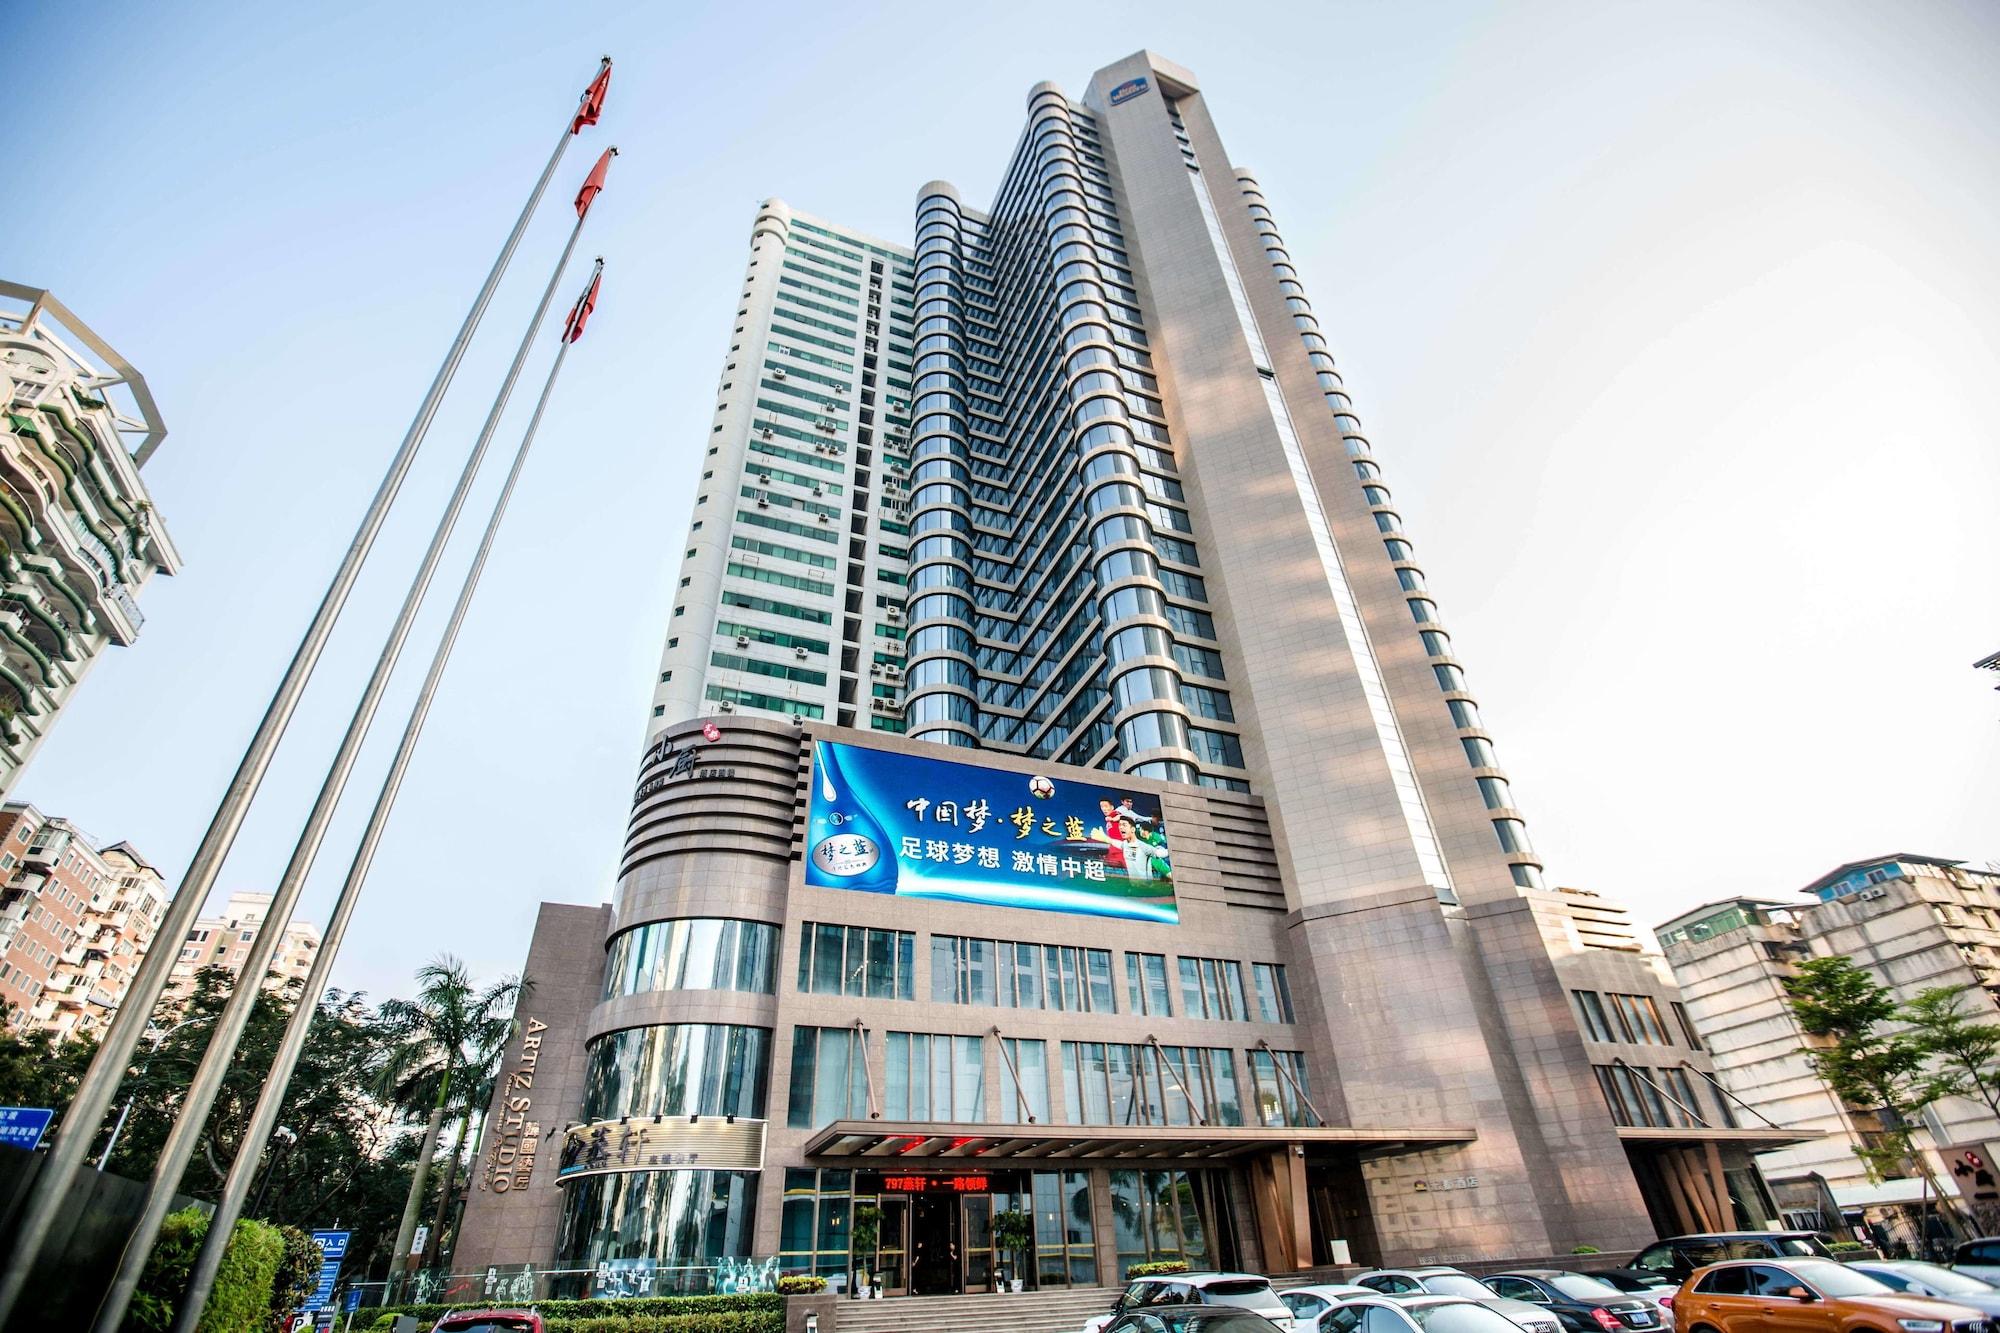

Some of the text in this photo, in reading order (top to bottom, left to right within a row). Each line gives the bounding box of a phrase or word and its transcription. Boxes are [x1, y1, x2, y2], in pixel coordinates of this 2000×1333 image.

[820, 839, 869, 864] 梦之蓝
[900, 836, 1000, 868] 足球梦想
[1011, 850, 1106, 881] 激情中超
[491, 1017, 549, 1194] ARTIZ STUDIO
[293, 1318, 304, 1332] P
